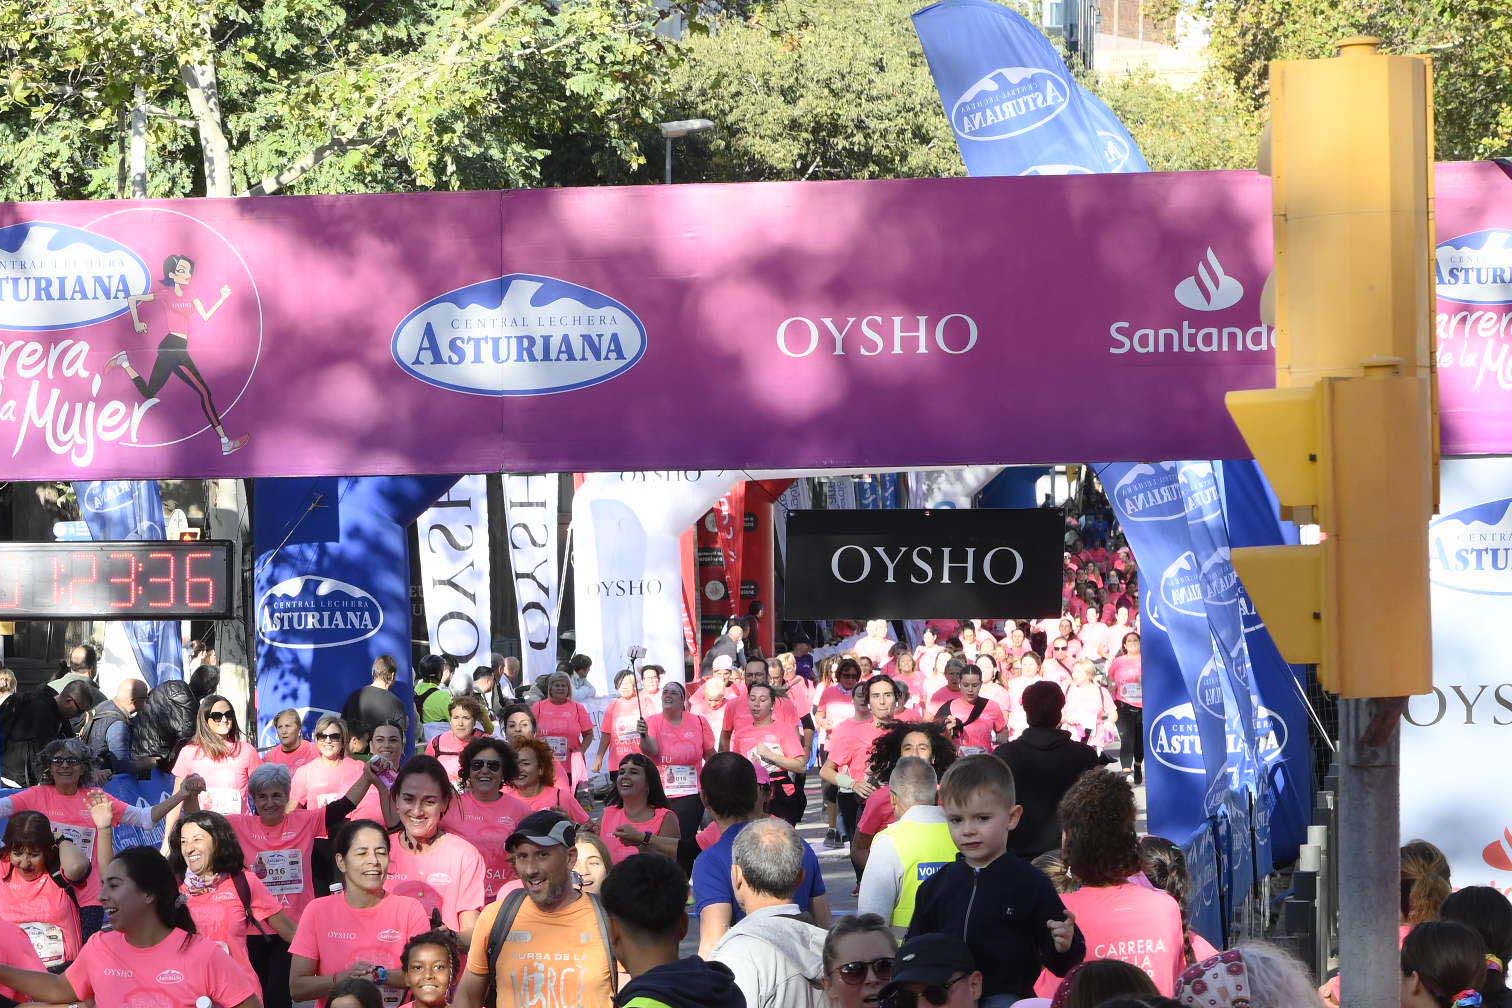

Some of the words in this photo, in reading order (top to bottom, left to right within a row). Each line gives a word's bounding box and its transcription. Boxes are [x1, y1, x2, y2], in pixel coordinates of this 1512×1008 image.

[451, 315, 530, 331] CENTRAL
[537, 313, 619, 328] LECHERA
[412, 321, 628, 367] ASTURIANA
[776, 314, 979, 358] OYSHO
[12, 373, 161, 468] Mujer
[831, 544, 1024, 586] OYSHO
[273, 600, 316, 609] CENTRAL
[320, 600, 370, 608] LECHERA
[261, 605, 374, 632] ASTURIANA
[268, 867, 286, 876] 016
[1094, 937, 1166, 959] CARRERA
